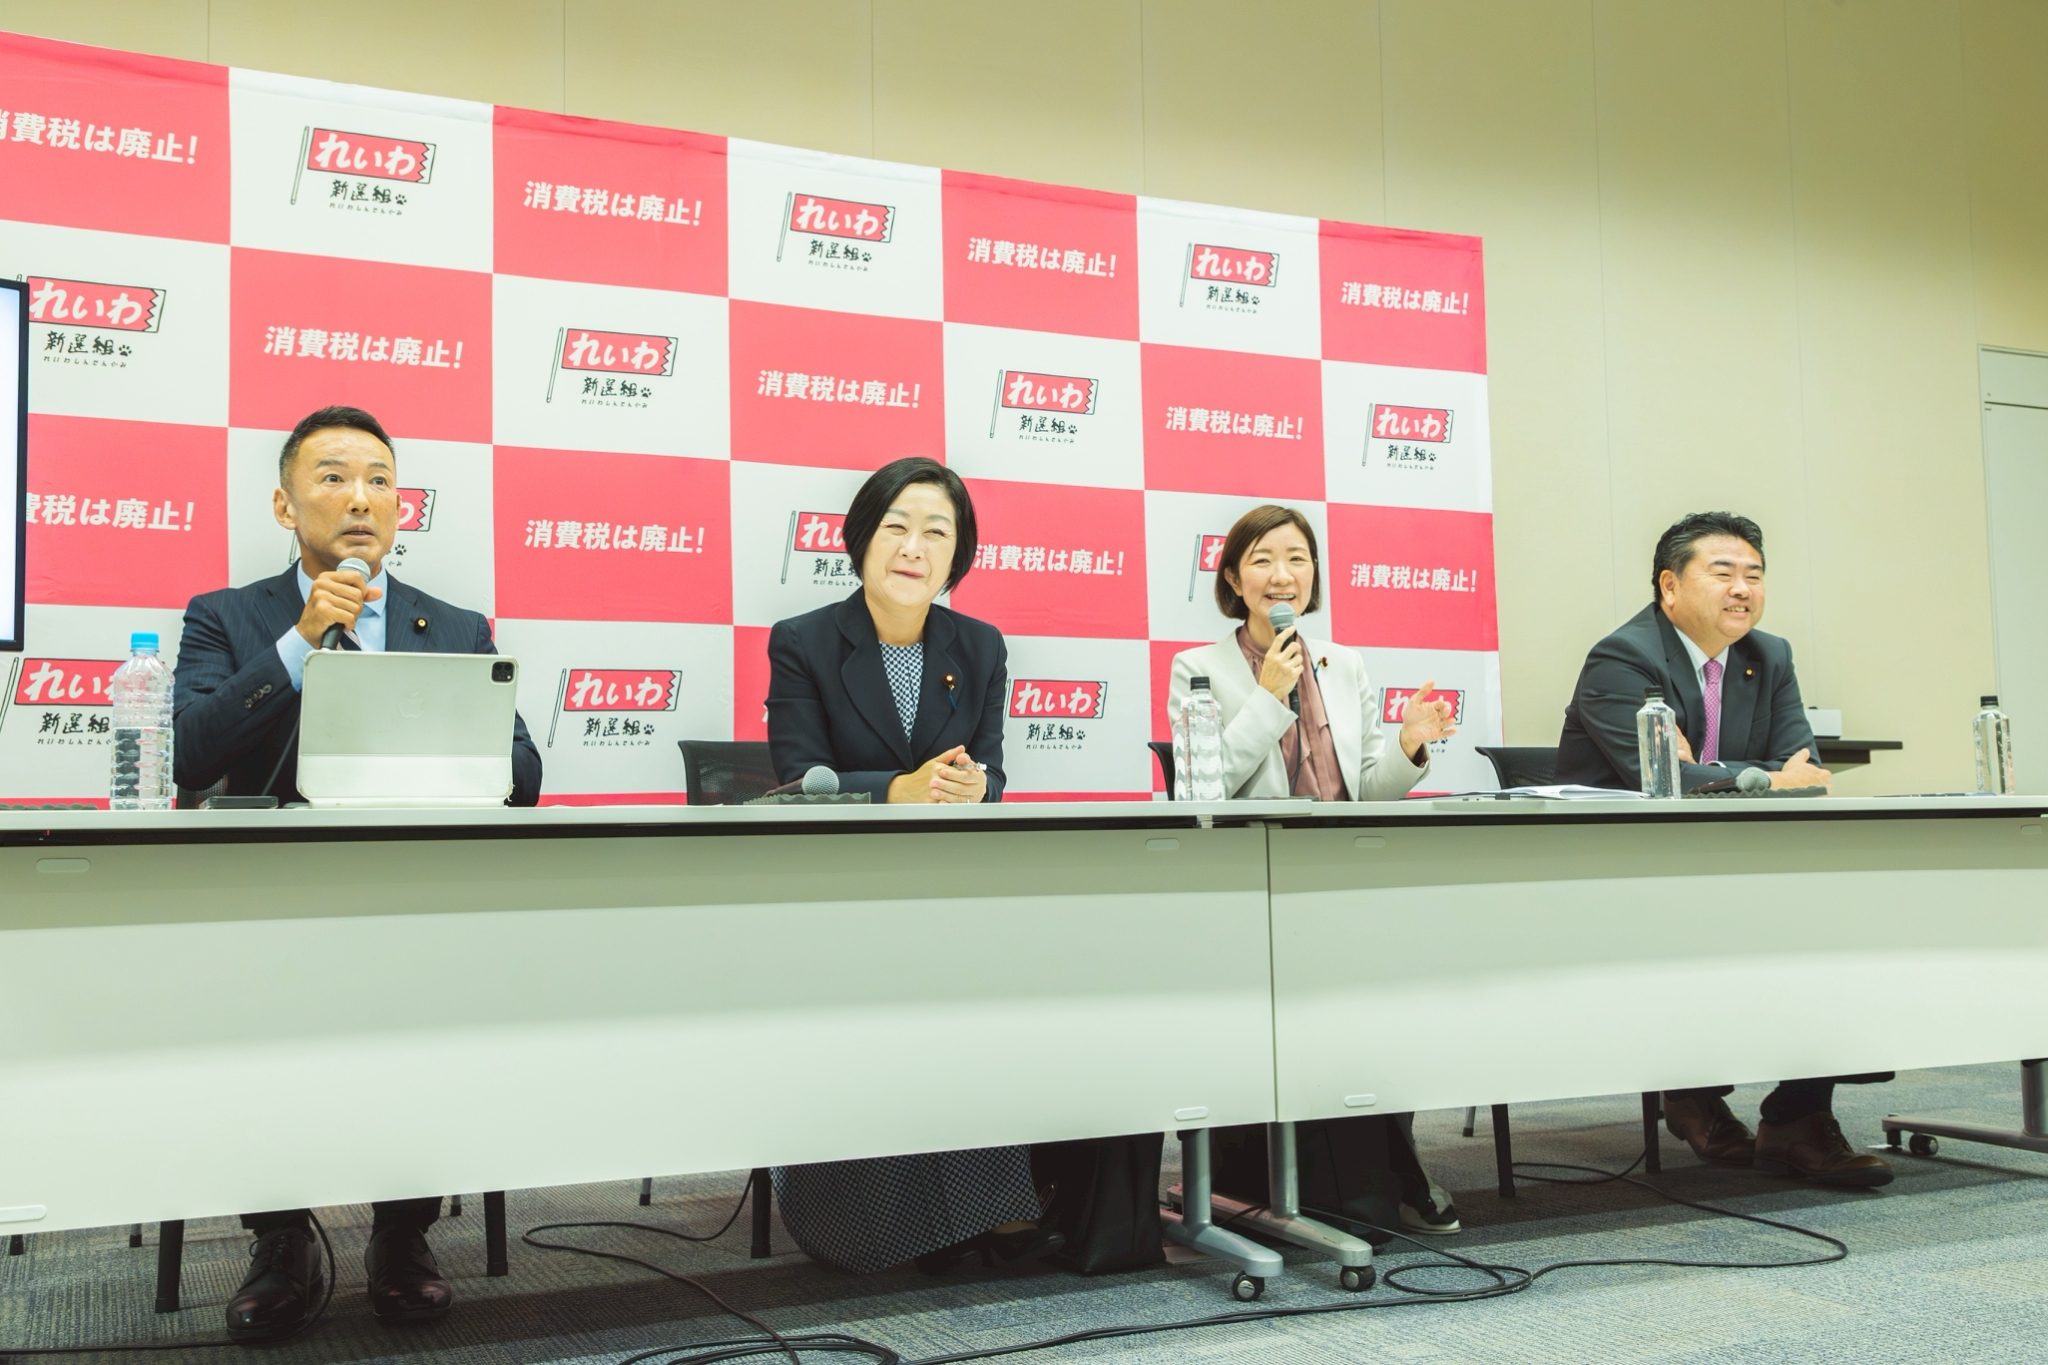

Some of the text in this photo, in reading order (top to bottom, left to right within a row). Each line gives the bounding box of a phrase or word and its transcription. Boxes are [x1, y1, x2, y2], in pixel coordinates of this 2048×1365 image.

[315, 133, 416, 177] れいわ
[330, 179, 392, 204] 新選組
[524, 181, 702, 227] 消費税は廃止!
[796, 197, 879, 236] れいわ
[808, 239, 860, 261] 新選組
[968, 237, 1117, 278] 消費税は廃止!
[1195, 247, 1266, 281] れいわ
[29, 281, 143, 325] れいわ
[1206, 285, 1250, 305] 新選組
[1341, 281, 1469, 315] 消費税は廃止!
[44, 330, 115, 356] 新選組
[264, 325, 463, 368] 消費税は廃止!
[568, 332, 660, 370] れいわ
[43, 354, 127, 368] れいわしんせんぐみ
[582, 376, 638, 398] 新選組
[757, 369, 921, 408] 消費税は廃止!
[1007, 374, 1084, 409] れいわ
[1019, 414, 1066, 434] 新選組
[1166, 406, 1303, 440] 消費税は廃止!
[1376, 407, 1441, 439] れいわ
[1386, 443, 1427, 462] 新選組
[27, 492, 194, 532] 税は廃止!
[525, 519, 705, 554] 消費税は廃止!
[974, 543, 1125, 576] 消費税は廃止!
[1351, 563, 1477, 593] 消費税は廃止!
[571, 672, 663, 708] れいわ
[1015, 682, 1092, 715] れいわ
[39, 711, 110, 735] 新選組
[584, 717, 641, 738] 新選組
[1026, 722, 1074, 742] 新選組
[37, 737, 112, 746] れいわしんせんぐ
